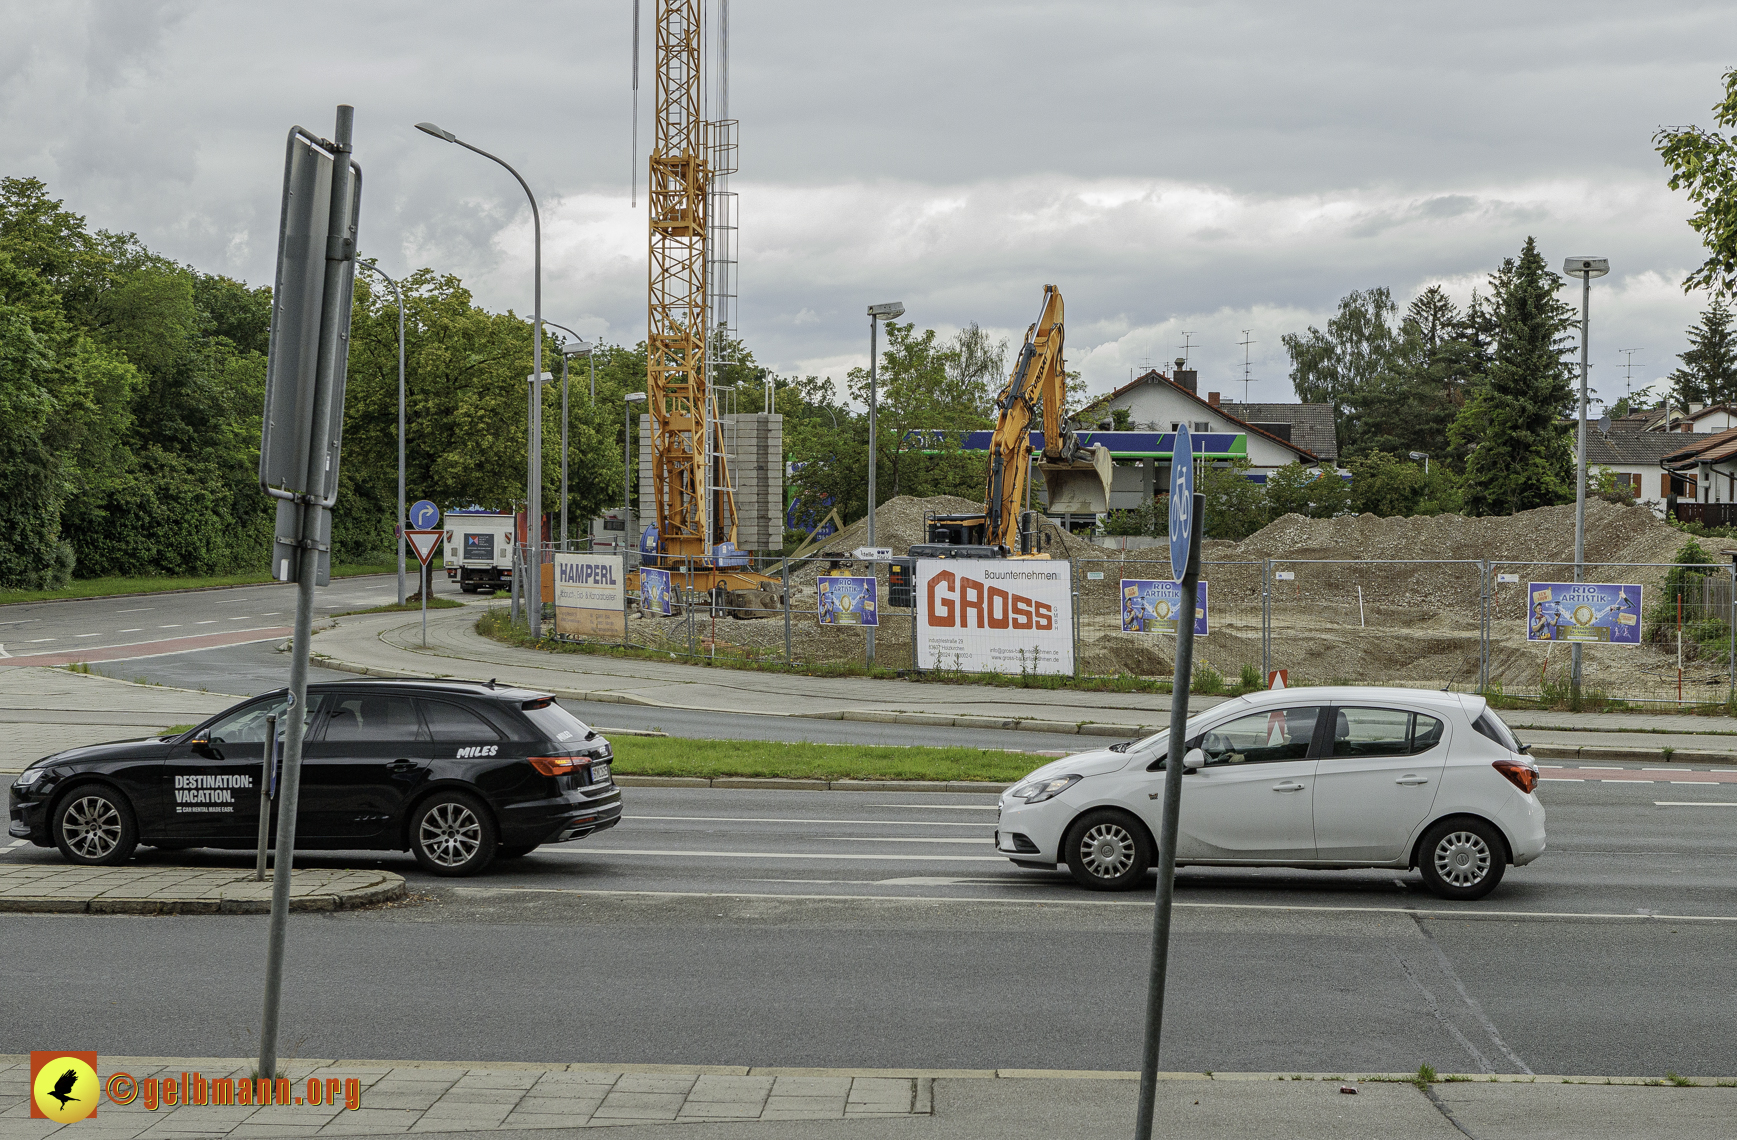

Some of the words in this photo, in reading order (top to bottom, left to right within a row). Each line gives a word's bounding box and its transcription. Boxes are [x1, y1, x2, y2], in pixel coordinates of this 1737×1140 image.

[560, 563, 616, 585] HAMPERL
[985, 569, 1057, 580] Bauunternehmen
[1145, 590, 1180, 598] ARTISTIK
[1572, 586, 1597, 594] RIO
[927, 569, 1053, 631] GROSS
[1561, 594, 1607, 603] ARTISTIK
[456, 745, 498, 758] MILES
[175, 775, 253, 788] DESTINATION:
[175, 790, 235, 803] VACATION.
